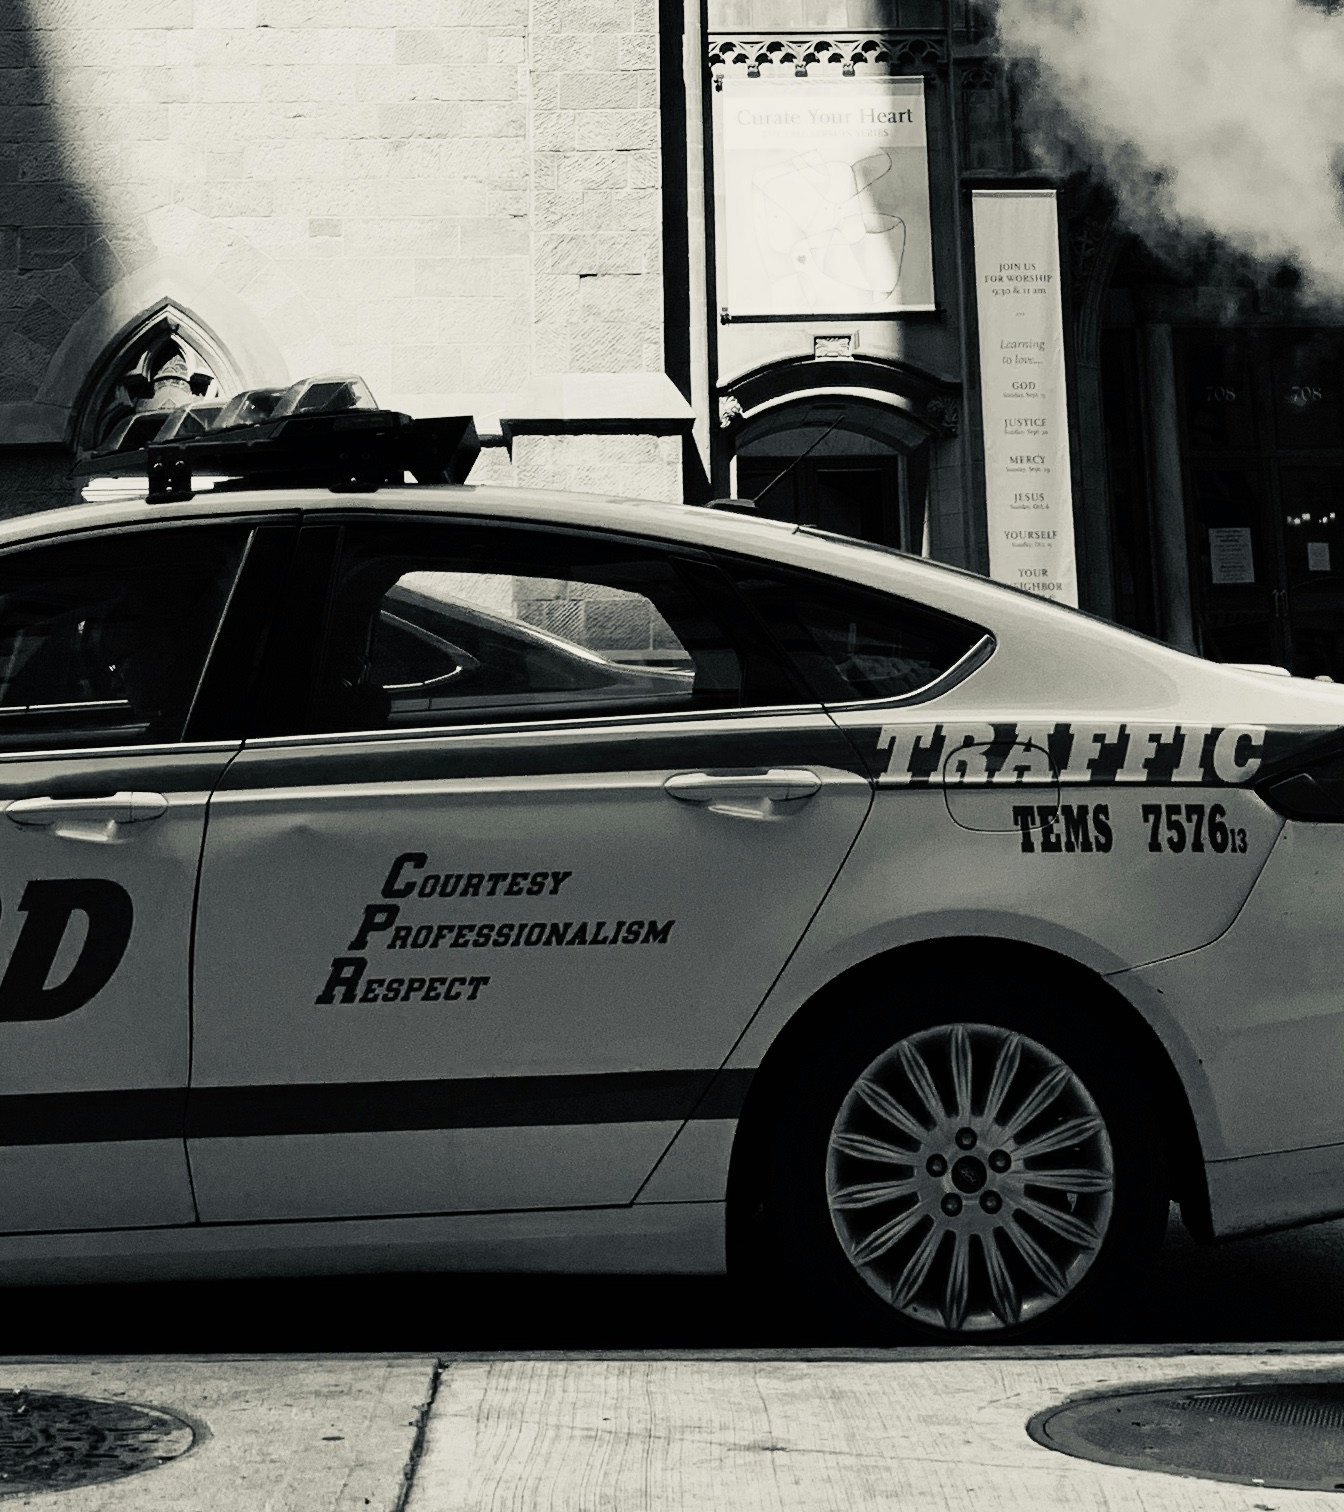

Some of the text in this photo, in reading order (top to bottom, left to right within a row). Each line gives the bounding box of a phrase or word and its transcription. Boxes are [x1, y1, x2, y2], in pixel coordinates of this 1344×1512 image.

[737, 107, 913, 126] Curate Your Heart
[999, 263, 1036, 273] JOIN US
[984, 274, 1053, 283] FOR WORSHIP
[992, 288, 1010, 296] 9:30
[1000, 339, 1046, 351] Learning
[1002, 356, 1013, 365] to
[1012, 381, 1036, 390] GOD
[1205, 386, 1236, 401] 708
[1291, 386, 1322, 401] 708
[1005, 418, 1047, 428] JUSTICE
[1010, 455, 1046, 464] MERCY
[1014, 493, 1045, 503] JESUS
[1004, 530, 1057, 540] YOURSELF
[1018, 569, 1048, 578] YOUR
[876, 722, 1267, 784] TRAFFIC
[1012, 803, 1113, 854] TEMS
[380, 852, 573, 899] COURTESY
[347, 903, 675, 951] PROFESSIONALISM
[314, 956, 490, 1005] RESPECT
